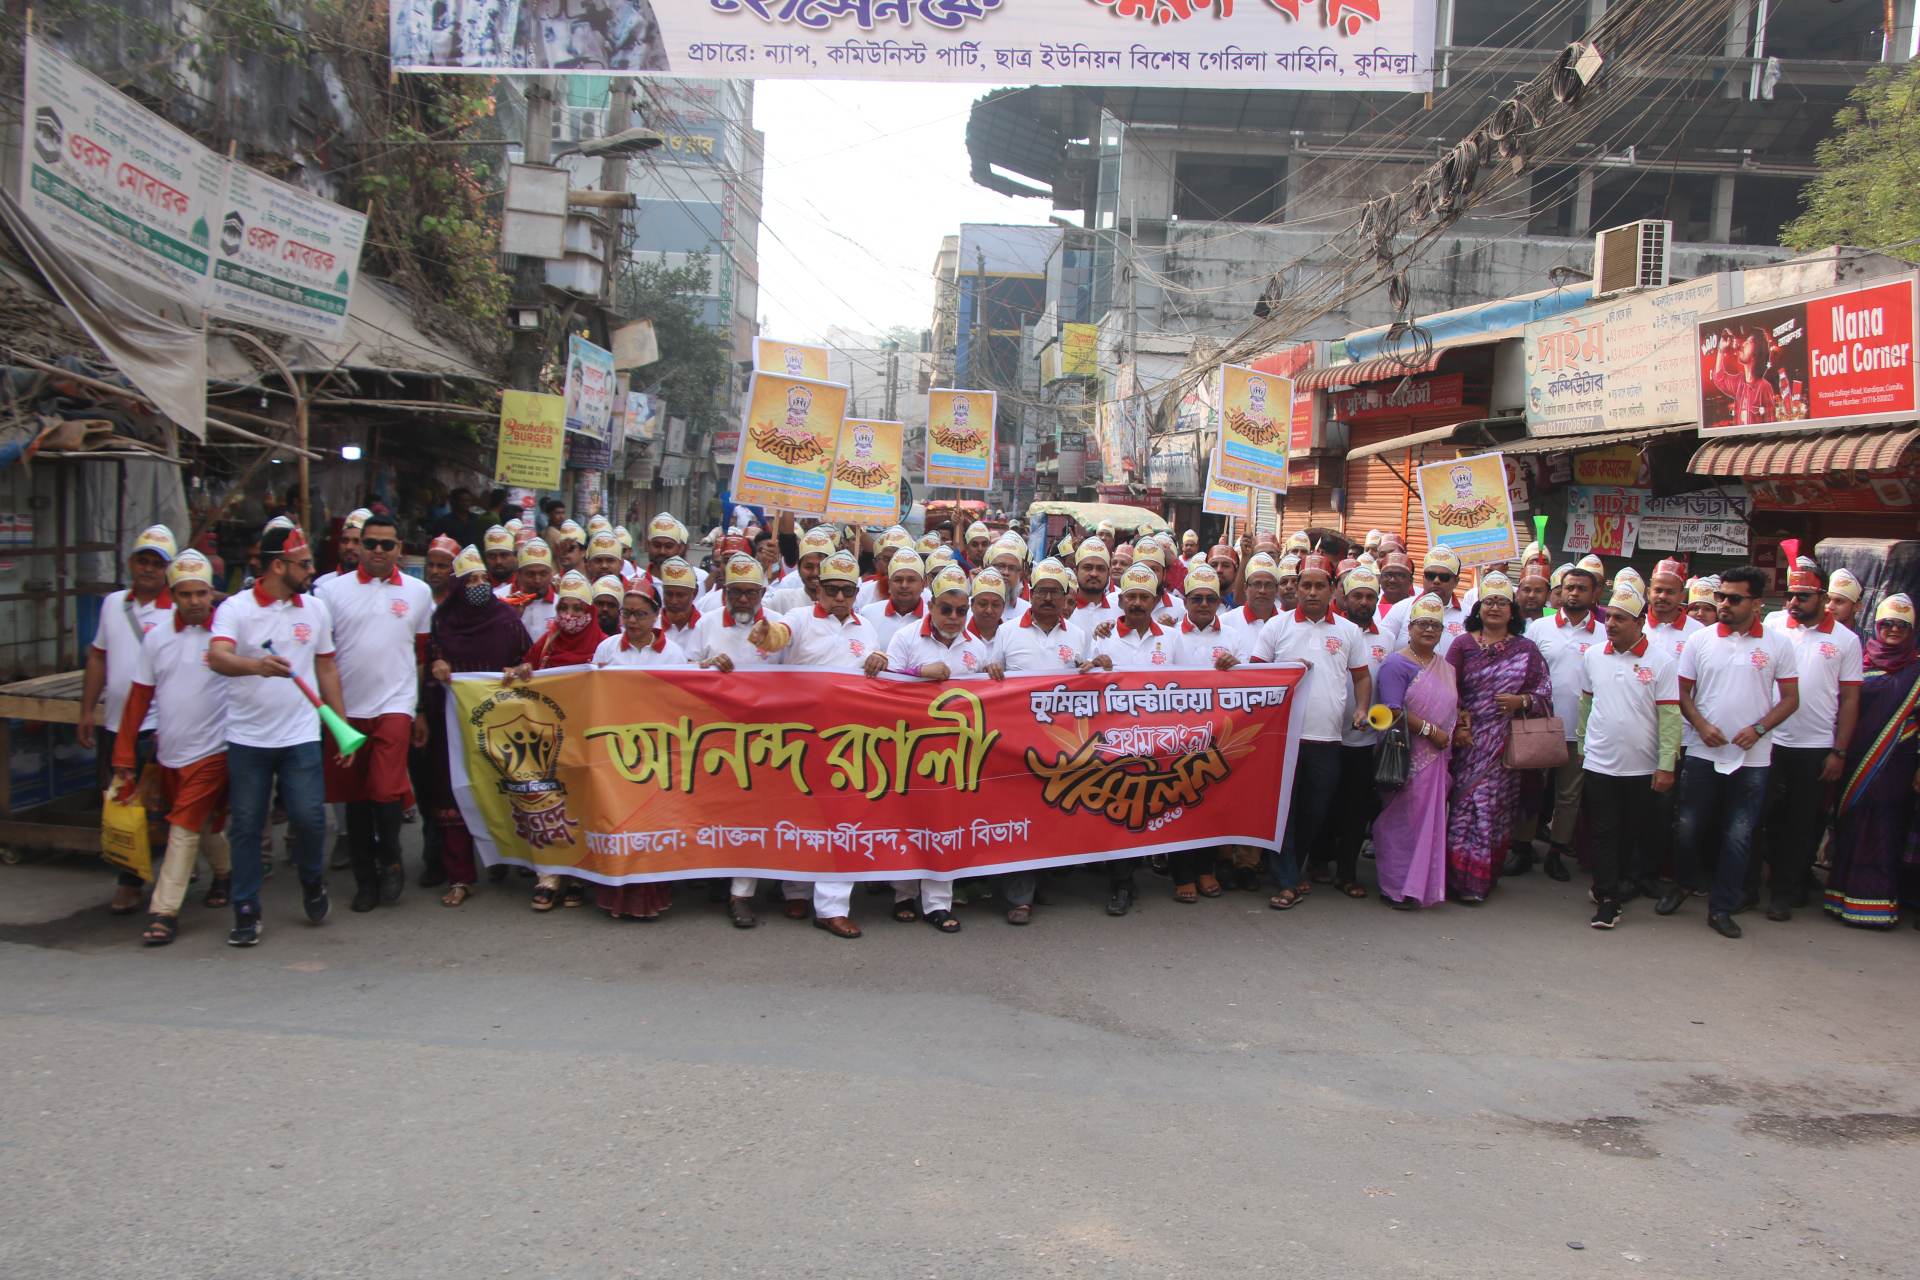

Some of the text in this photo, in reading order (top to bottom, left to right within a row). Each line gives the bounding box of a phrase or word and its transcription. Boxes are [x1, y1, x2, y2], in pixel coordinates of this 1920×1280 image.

[688, 41, 754, 63] প্রচারে:
[764, 43, 817, 67] ন্যাপ,
[825, 39, 927, 66] কমিউনিস্ট
[936, 41, 986, 71] পার্টি,
[994, 47, 1032, 70] ছাত্র
[1040, 43, 1121, 71] ইউনিয়ন
[1130, 43, 1190, 71] বিশেষ
[1198, 45, 1268, 72] গেরিলা
[1353, 47, 1417, 77] কুমিল্লা
[117, 161, 191, 215] মোবারক
[282, 239, 336, 273] মোবারক
[1831, 304, 1884, 343] Nana
[1537, 316, 1605, 374] প্রাইম
[1812, 342, 1910, 378] Food Corner
[1548, 371, 1604, 398] কম্পিউটার
[513, 431, 553, 445] BURGER
[1029, 682, 1290, 724] কুমিল্লা ভিক্টোরিয়া কলেজ
[585, 715, 815, 796] আনন্দ
[1094, 721, 1214, 758] প্রথম বাংলা
[695, 823, 769, 850] প্রাক্তন
[970, 817, 1032, 848] বিভাগ
[1147, 806, 1184, 832] ২০২৩
